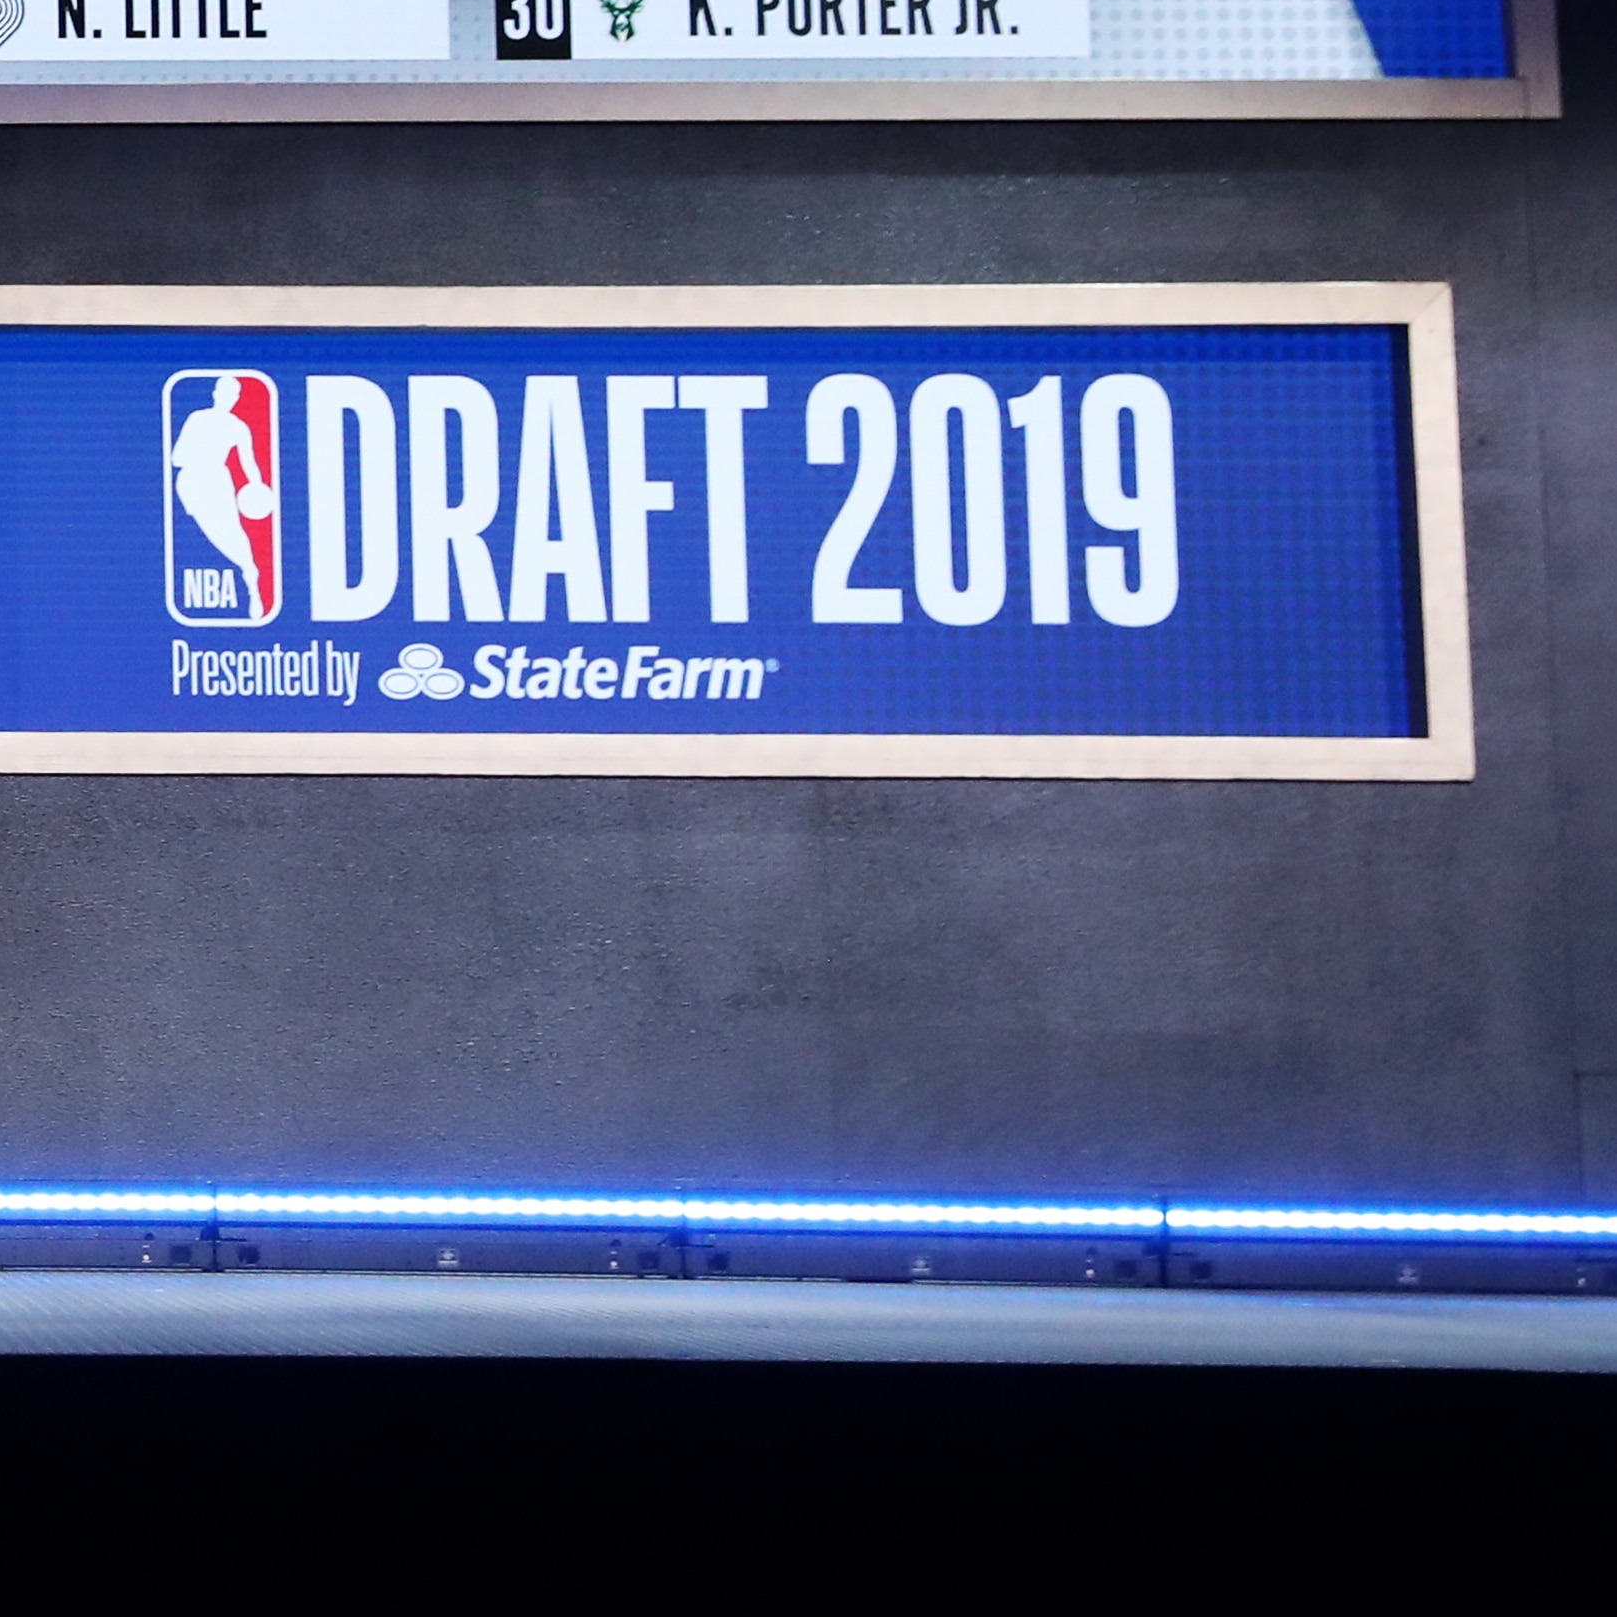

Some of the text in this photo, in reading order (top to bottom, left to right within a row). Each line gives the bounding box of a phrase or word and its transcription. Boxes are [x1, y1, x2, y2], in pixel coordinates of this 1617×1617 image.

[306, 373, 1178, 627] DRAFT 2019
[183, 568, 238, 609] NBA
[172, 639, 319, 697] Presented
[325, 640, 360, 706] by
